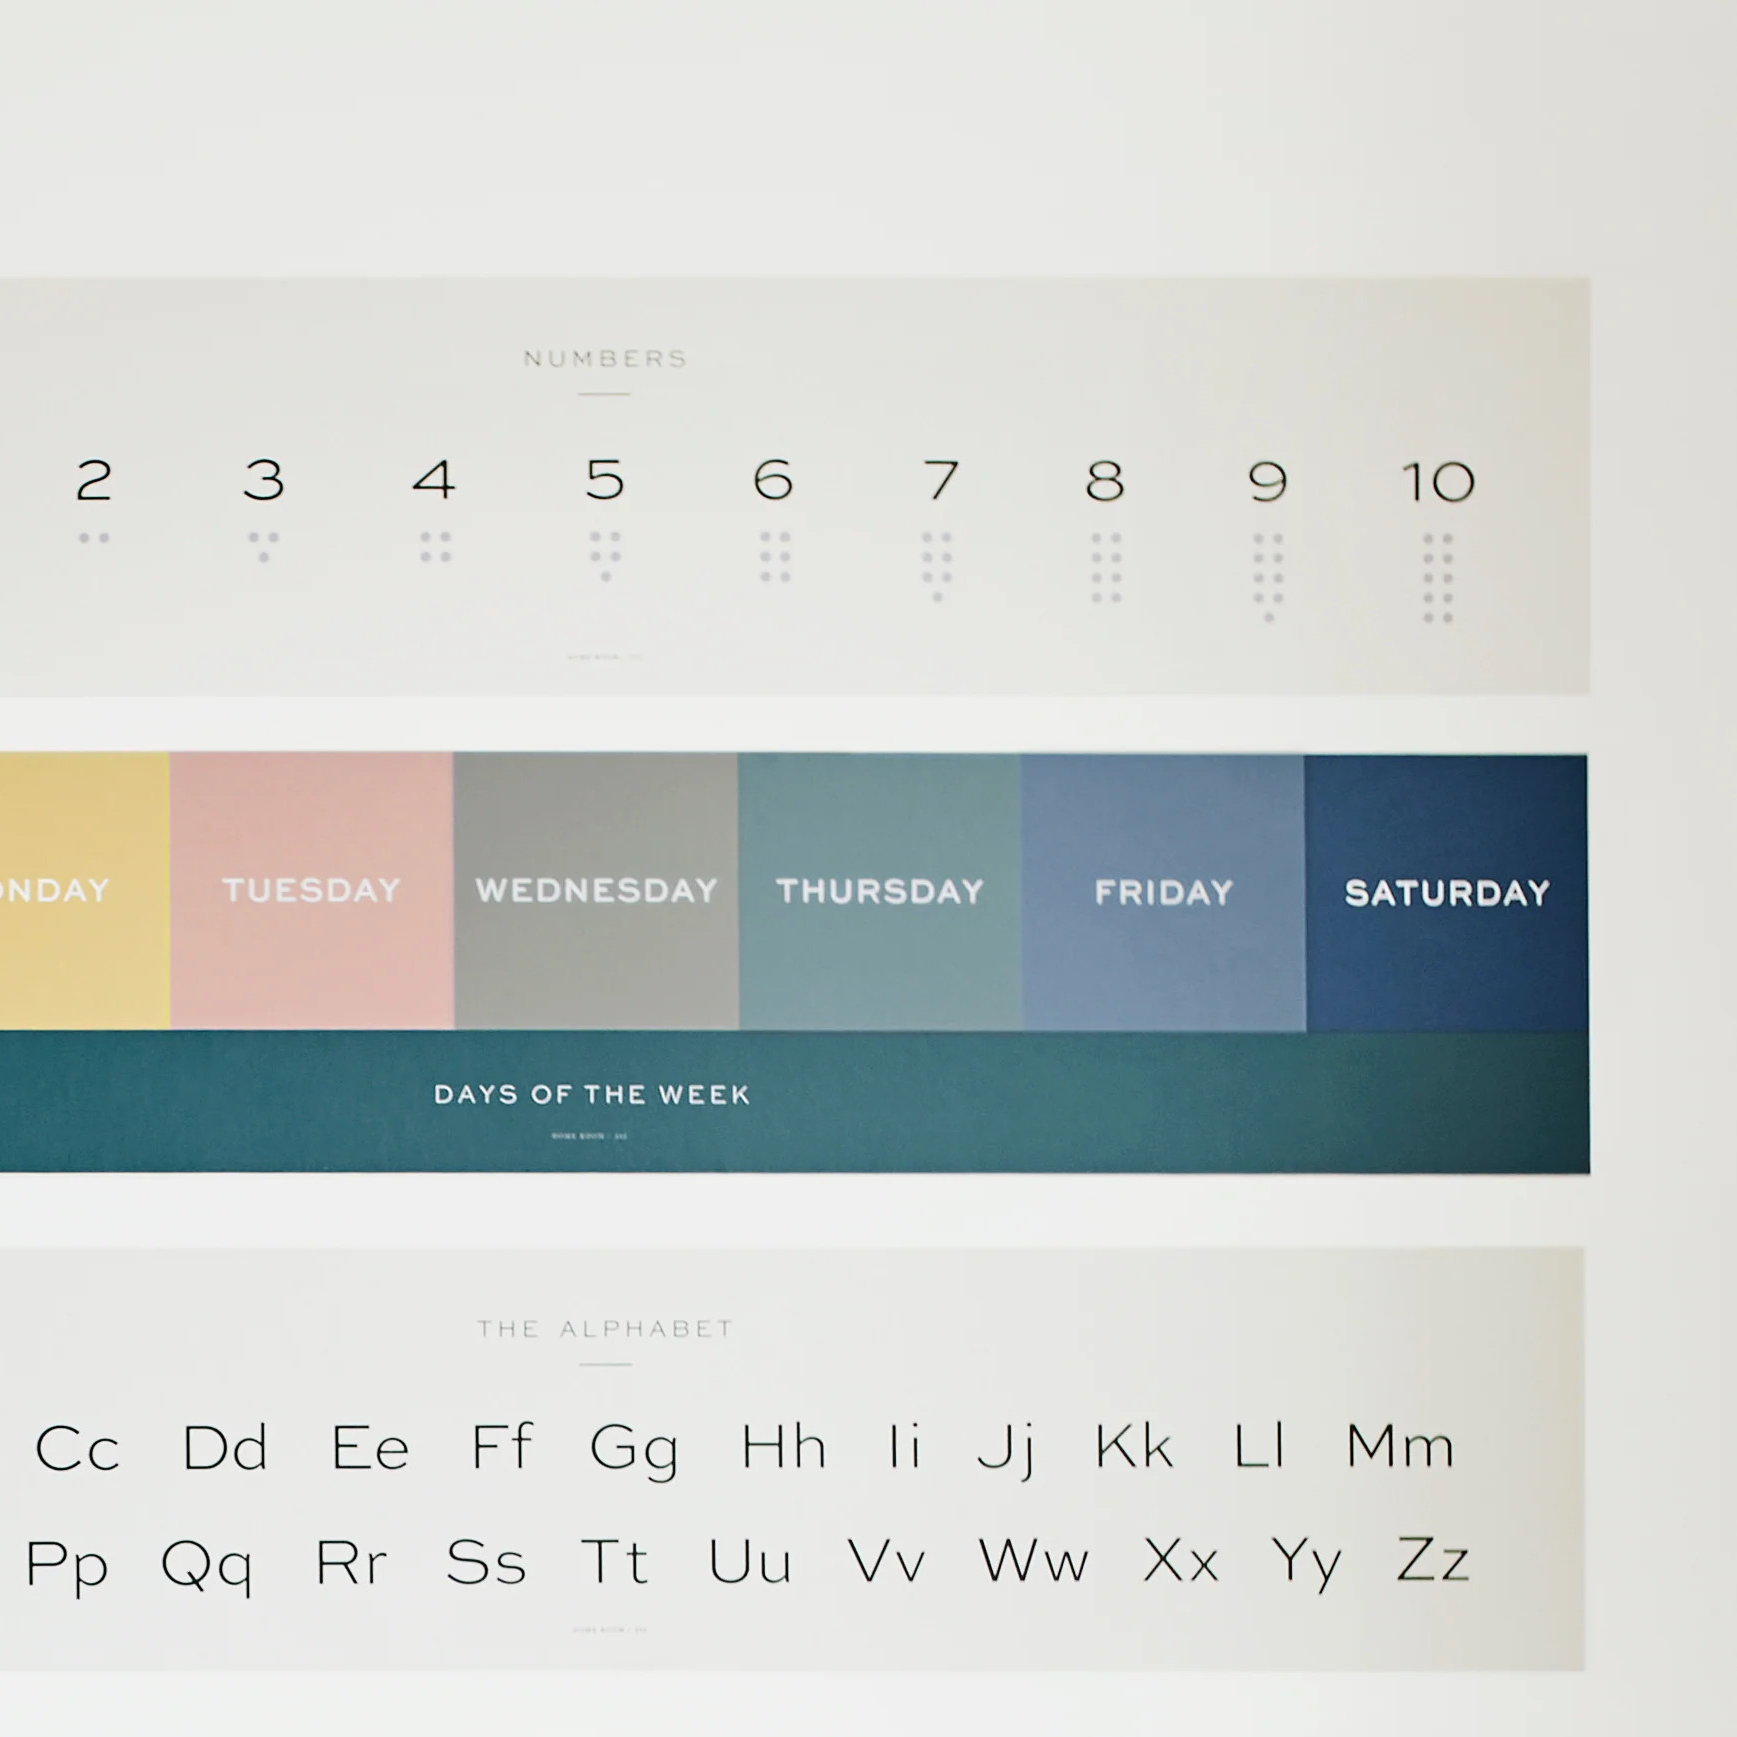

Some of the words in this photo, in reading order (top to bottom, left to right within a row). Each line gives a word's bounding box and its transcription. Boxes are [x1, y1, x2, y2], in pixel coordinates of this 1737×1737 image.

[524, 349, 685, 368] NUMBERS
[77, 459, 111, 501] 2
[243, 458, 284, 501] 3
[412, 459, 456, 500] 4
[586, 459, 624, 501] 5
[754, 458, 793, 501] 6
[924, 460, 959, 500] 7
[1086, 460, 1125, 502] 8
[1248, 461, 1288, 503] 9
[1403, 461, 1476, 503] 10
[222, 877, 400, 903] TUESDAY
[475, 877, 718, 904] WEDNESDAY
[775, 878, 984, 905] THURSDAY
[1095, 879, 1233, 906] FRIDAY
[1345, 878, 1550, 907] SATURDAY
[435, 1084, 518, 1105] DAYS
[531, 1084, 572, 1105] OF
[583, 1084, 646, 1105] THE
[658, 1084, 750, 1105] WEEK
[477, 1319, 538, 1338] THE
[560, 1319, 731, 1338] ALPHABET
[36, 1424, 119, 1472] Cc
[185, 1421, 266, 1471] Dd
[334, 1425, 409, 1470] Ee
[474, 1420, 535, 1469] Ff
[591, 1423, 677, 1484] Gg
[744, 1421, 825, 1469] Hh
[891, 1422, 918, 1468] Ii
[977, 1422, 1032, 1483] Jj
[1097, 1420, 1173, 1468] Kk
[1236, 1420, 1282, 1468] Ll
[1349, 1423, 1453, 1468] Mm
[28, 1541, 108, 1600] Pp
[162, 1539, 251, 1600] Qq
[318, 1540, 388, 1585] Rr
[447, 1538, 526, 1585] Ss
[580, 1539, 648, 1585] Tt
[711, 1538, 790, 1584] Uu
[847, 1538, 925, 1583] Vv
[978, 1537, 1089, 1582] Ww
[1144, 1537, 1219, 1582] Xx
[1271, 1537, 1342, 1595] Yy
[1397, 1536, 1470, 1581] Zz
